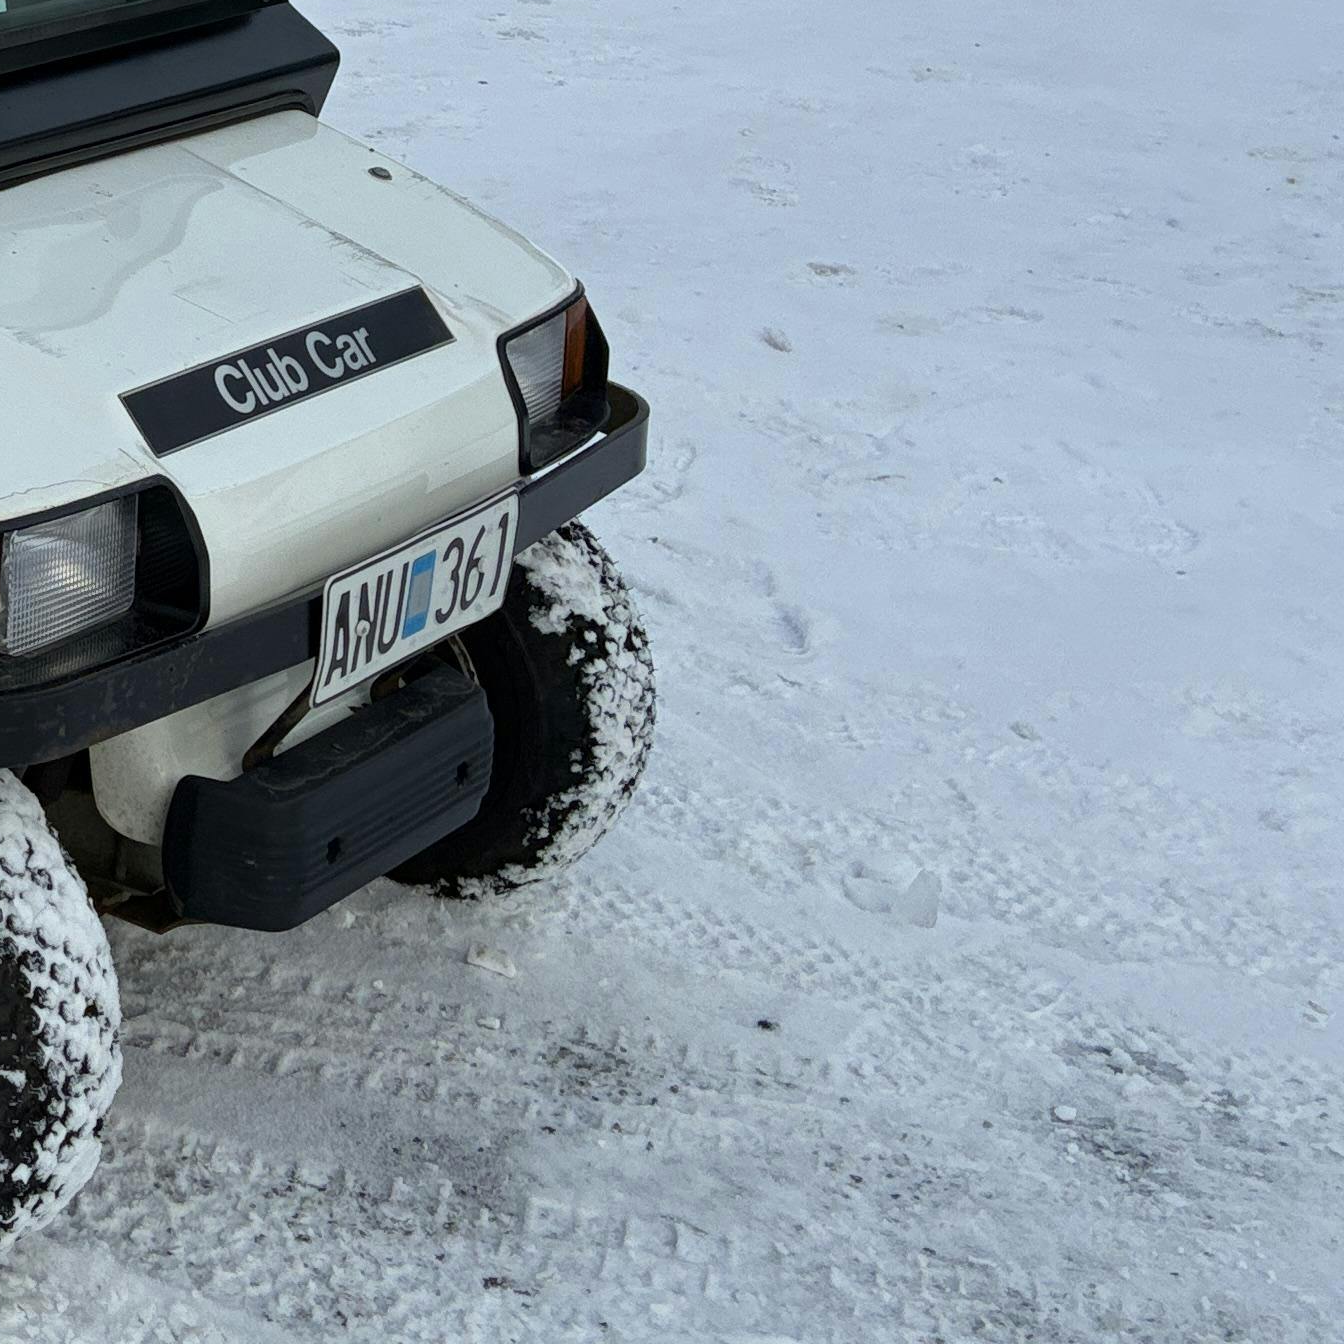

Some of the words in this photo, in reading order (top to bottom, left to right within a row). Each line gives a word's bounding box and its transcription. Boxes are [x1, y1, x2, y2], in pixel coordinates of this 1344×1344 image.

[213, 348, 309, 414] Club
[304, 327, 377, 379] Car
[323, 561, 410, 688] ANU
[435, 511, 510, 625] 361
